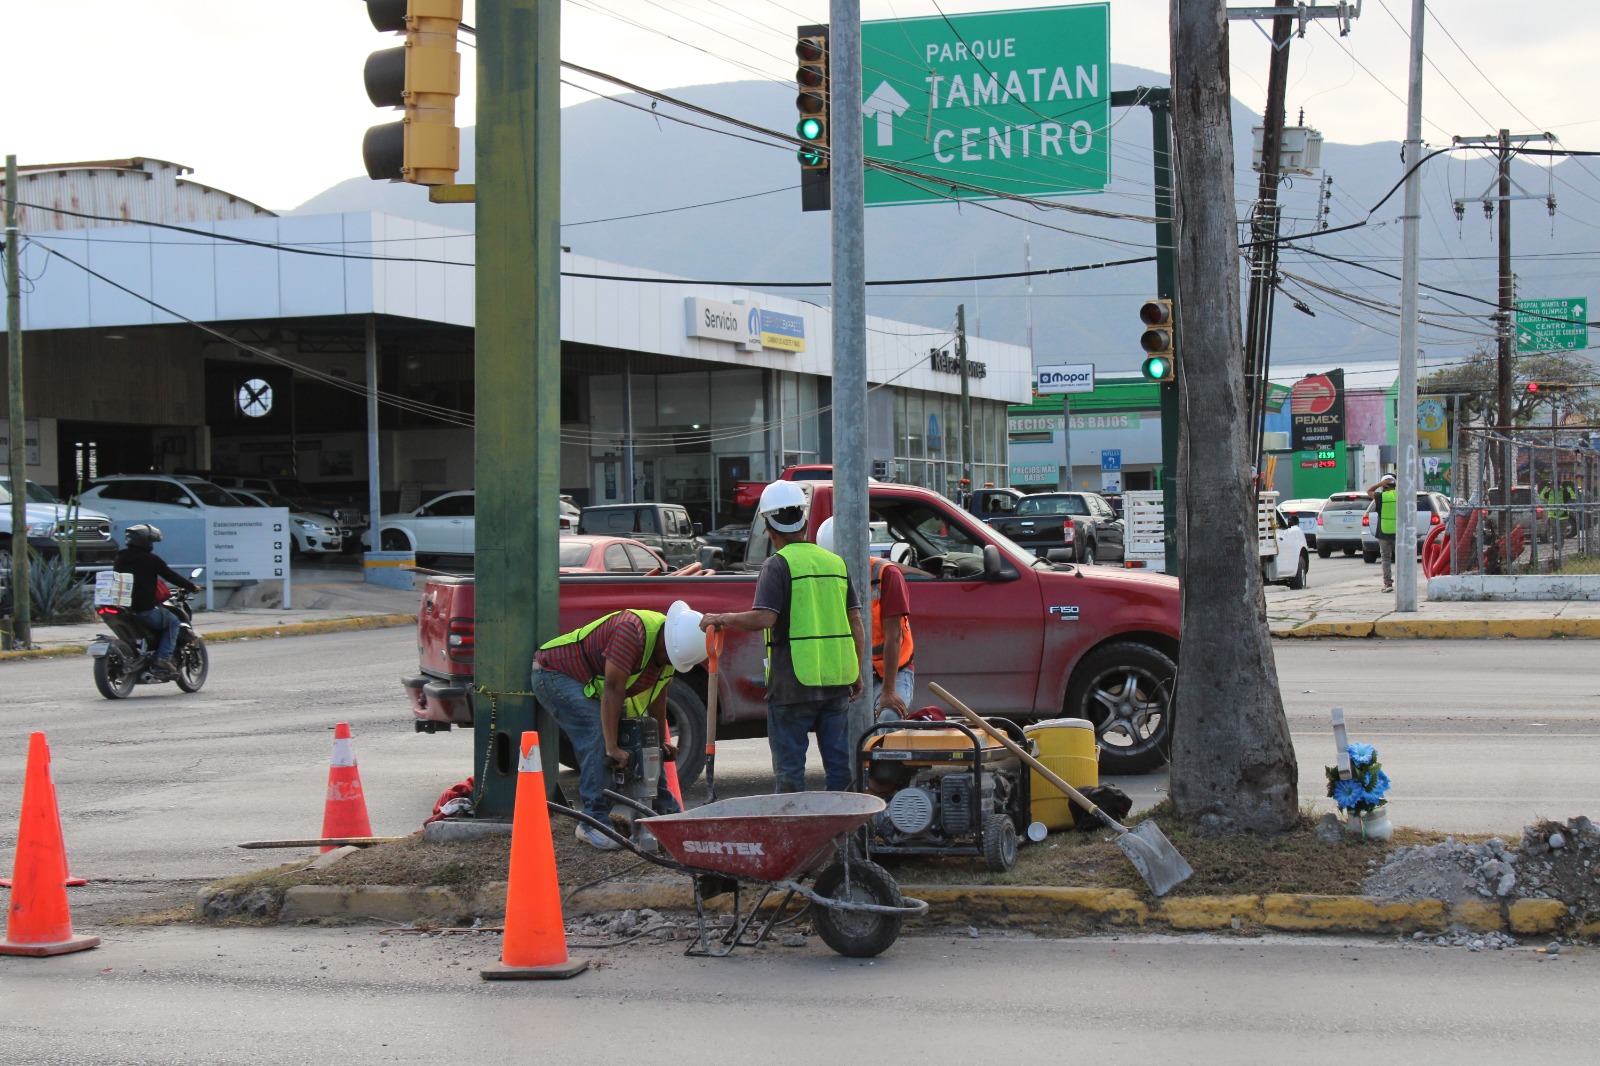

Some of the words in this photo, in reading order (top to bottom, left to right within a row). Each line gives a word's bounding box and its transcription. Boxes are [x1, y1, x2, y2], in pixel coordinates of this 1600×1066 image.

[926, 38, 1016, 63] PARQUE
[925, 64, 1099, 109] TAMATAN
[933, 120, 1093, 163] CENTRO
[705, 308, 738, 332] Servicio
[1009, 417, 1055, 431] RECIOS
[1088, 415, 1128, 429] BAJOS
[1295, 415, 1339, 425] PEMEX
[1318, 451, 1335, 459] 23.99
[1012, 466, 1040, 475] PRECIOS
[682, 840, 765, 856] SURTEK
